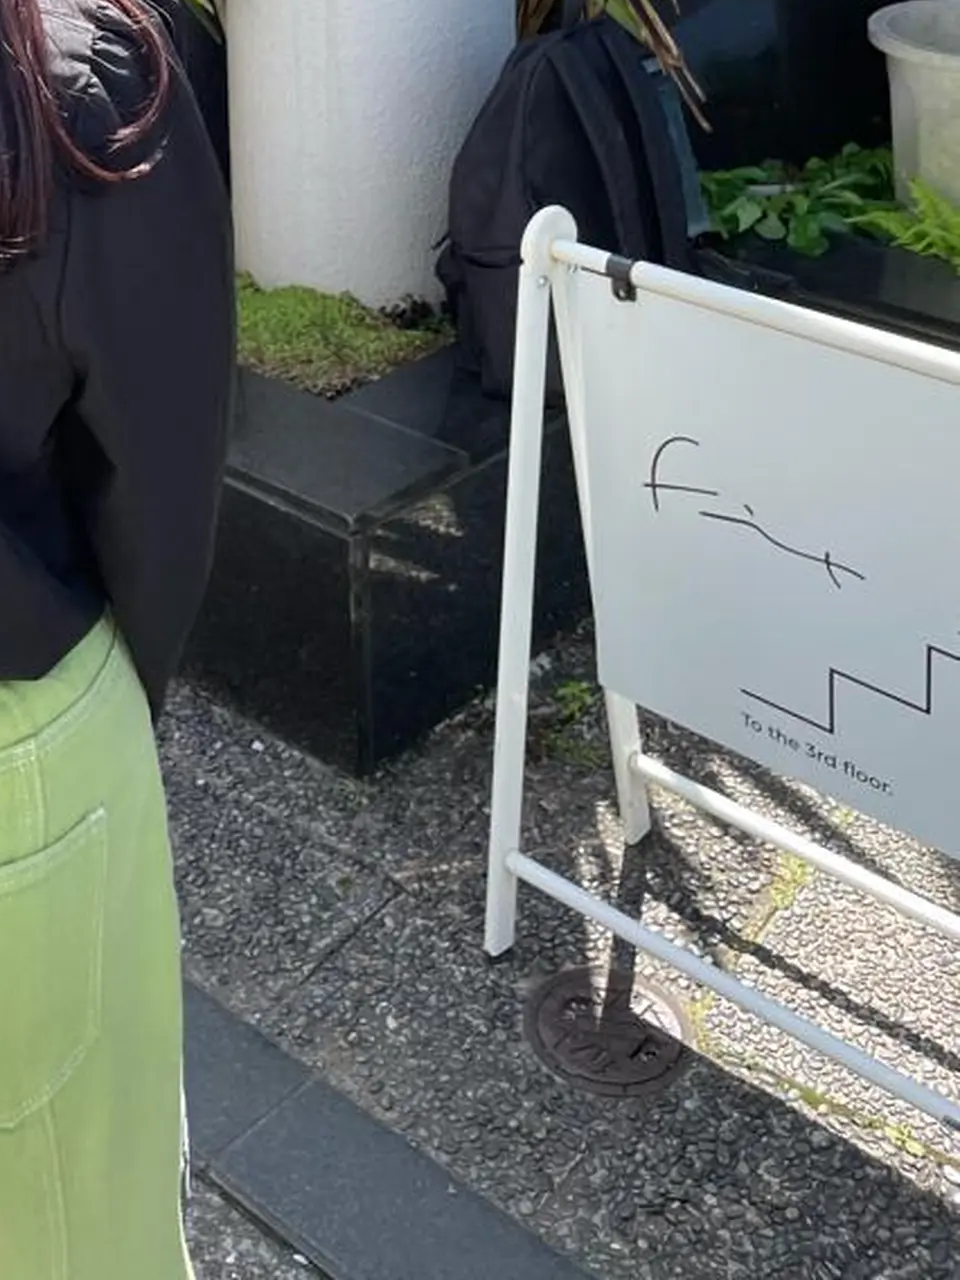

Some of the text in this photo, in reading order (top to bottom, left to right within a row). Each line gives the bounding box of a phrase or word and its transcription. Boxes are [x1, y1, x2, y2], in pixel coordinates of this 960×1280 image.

[741, 711, 894, 796] To the 3rd floor.
